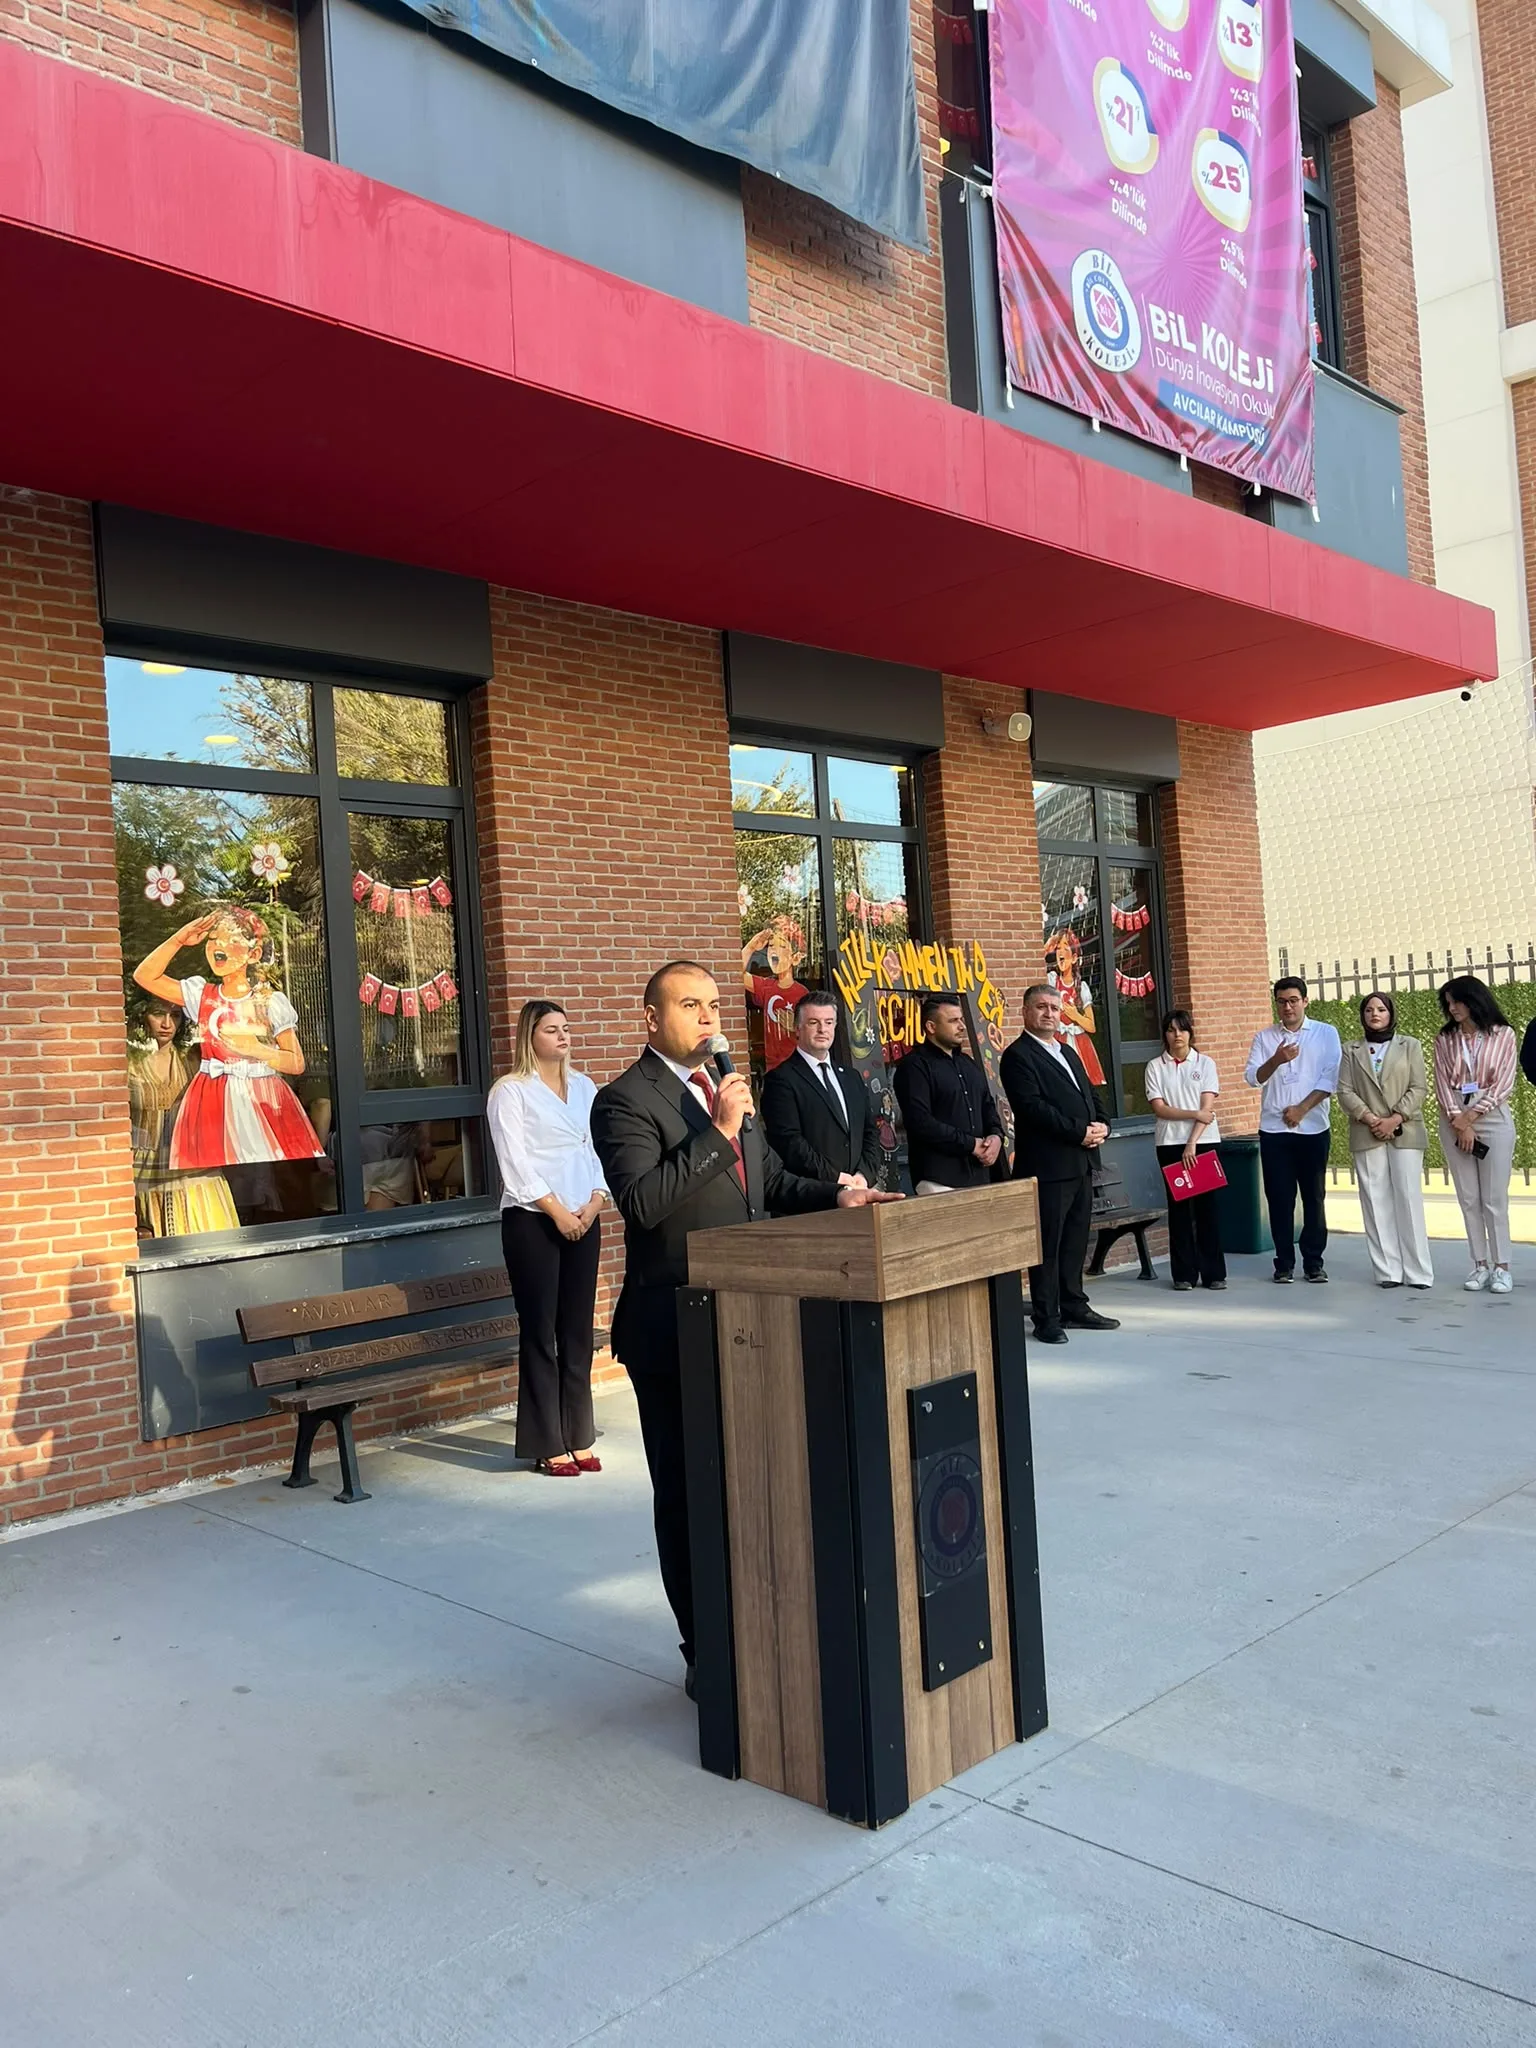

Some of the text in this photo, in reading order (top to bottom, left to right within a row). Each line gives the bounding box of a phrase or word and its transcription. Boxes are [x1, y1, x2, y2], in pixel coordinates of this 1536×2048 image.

[1147, 49, 1192, 82] Dilimde
[1111, 197, 1148, 236] Dilimde
[1155, 346, 1194, 381] Dünya
[1242, 393, 1276, 420] Okulu
[1173, 392, 1266, 447] AVCILAR KAMPÜSÜ
[300, 1292, 392, 1321] AVCILAR
